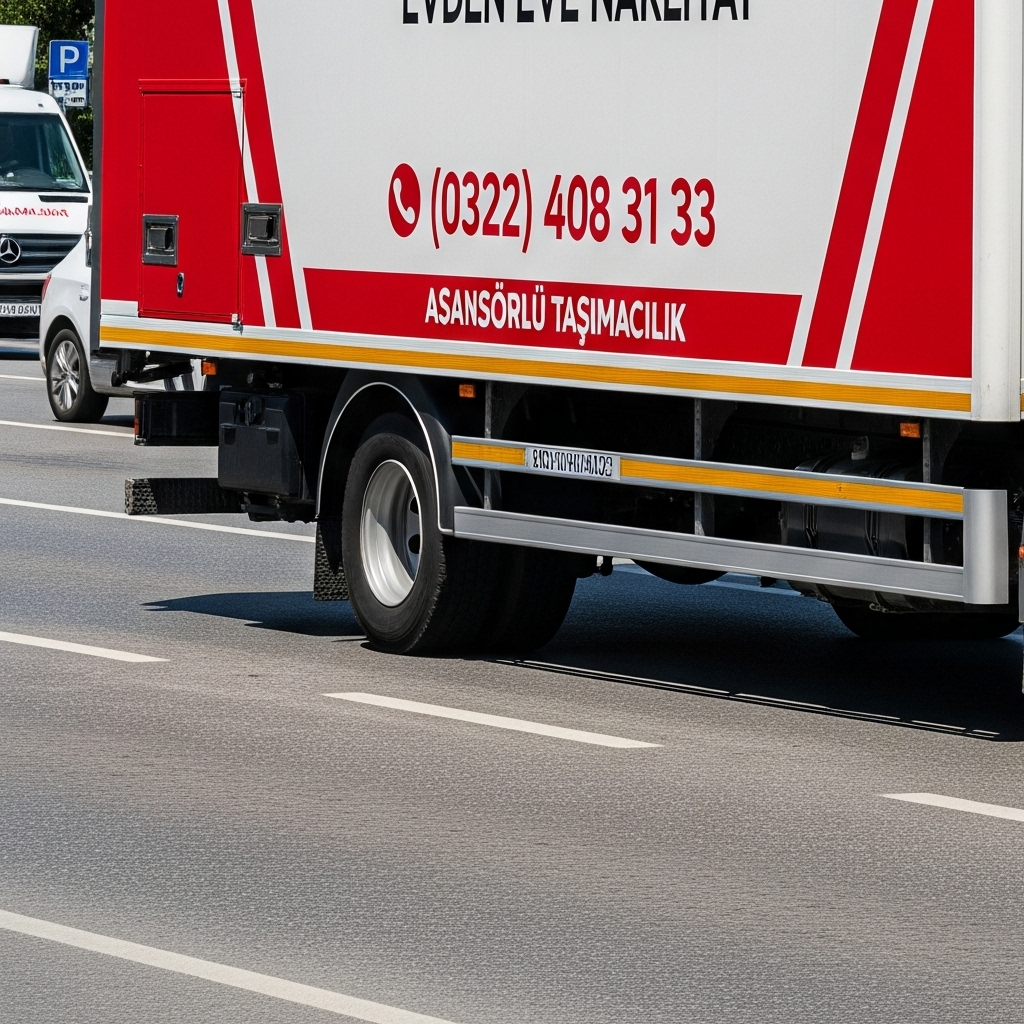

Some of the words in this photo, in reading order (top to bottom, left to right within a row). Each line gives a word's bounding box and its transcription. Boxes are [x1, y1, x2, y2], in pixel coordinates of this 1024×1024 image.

[60, 45, 80, 73] P
[431, 166, 533, 254] (0322)
[543, 174, 611, 242] 408
[621, 176, 658, 244] 31
[670, 177, 716, 247] 33
[550, 295, 688, 347] TAŞIMACILIK
